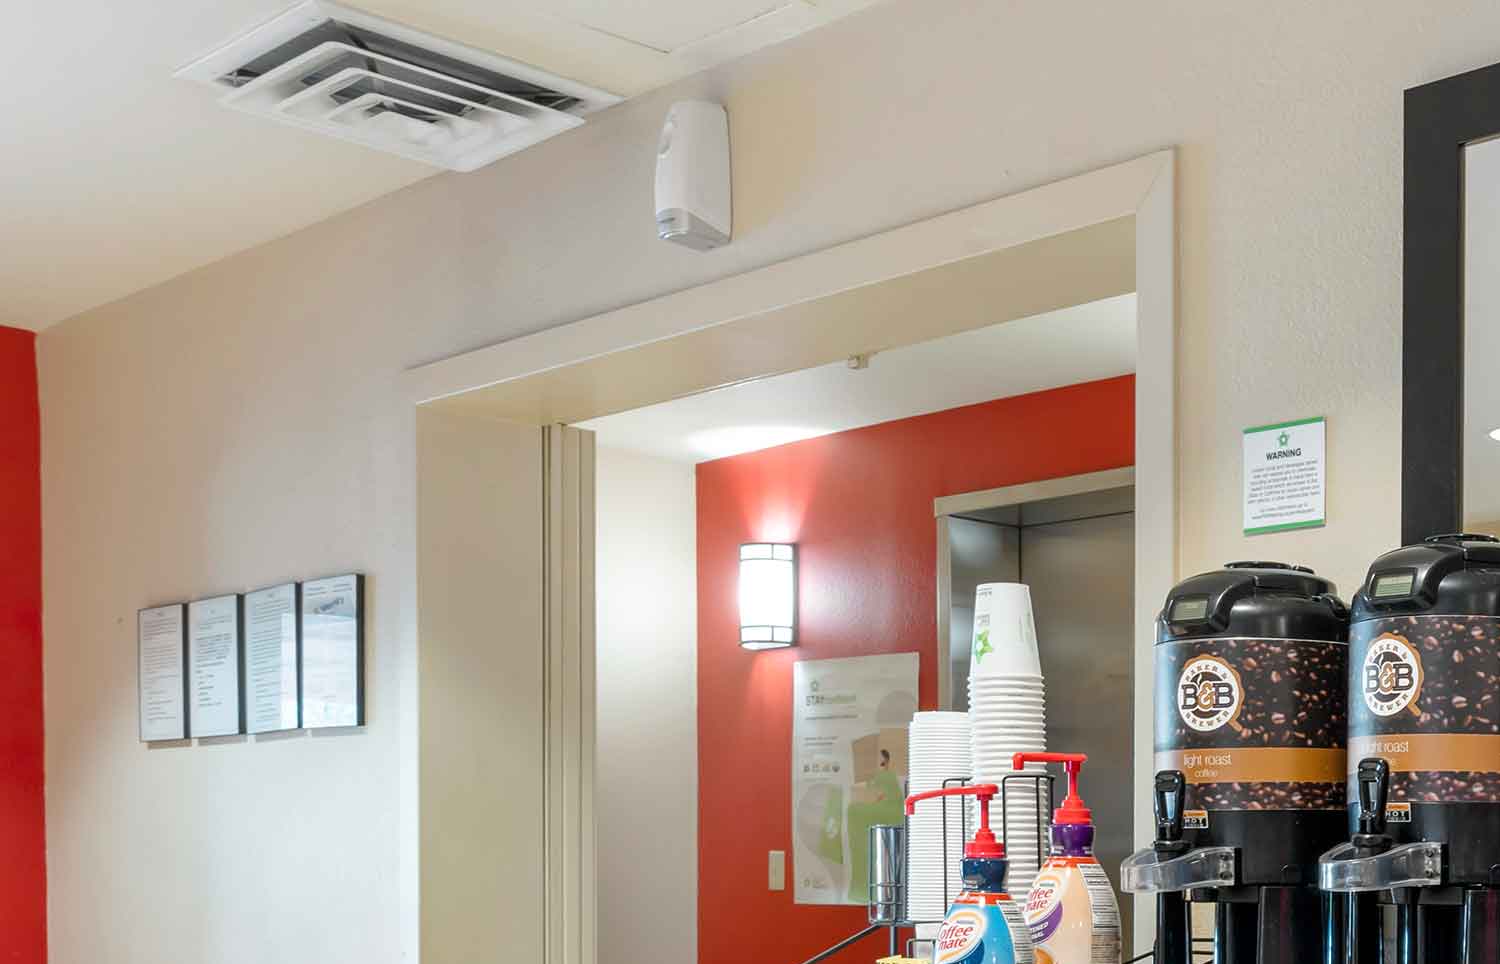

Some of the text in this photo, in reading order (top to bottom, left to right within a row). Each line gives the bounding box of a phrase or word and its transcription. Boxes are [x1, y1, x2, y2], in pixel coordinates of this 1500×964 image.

[1266, 447, 1302, 461] WARNING
[1366, 661, 1413, 693] B&B
[1181, 681, 1235, 711] B&B
[1184, 752, 1232, 768] light roast
